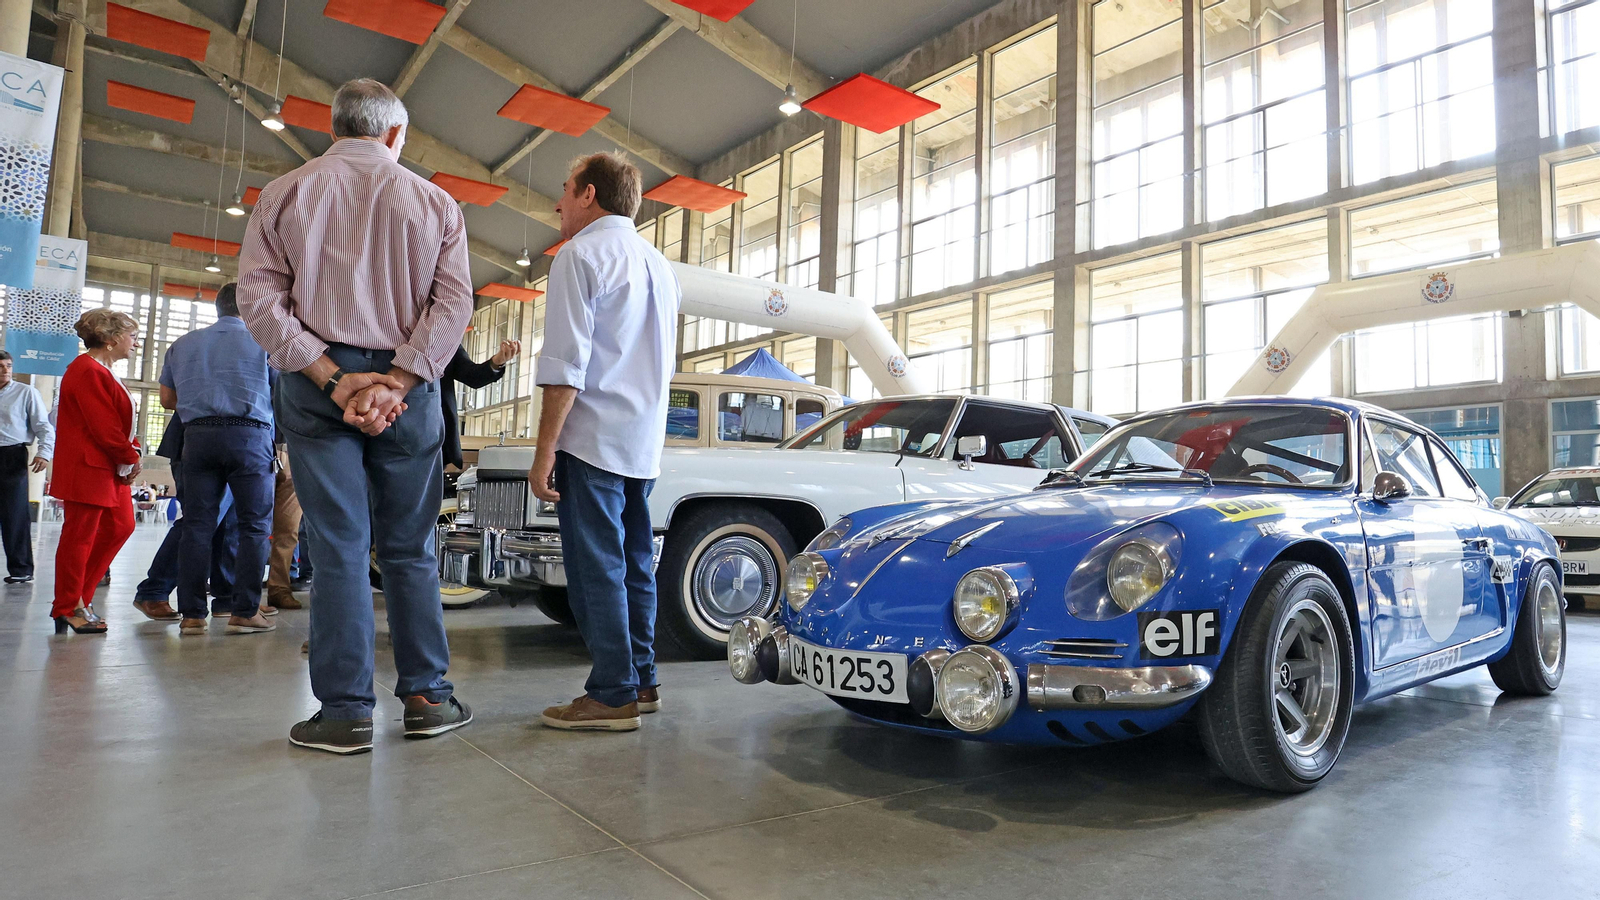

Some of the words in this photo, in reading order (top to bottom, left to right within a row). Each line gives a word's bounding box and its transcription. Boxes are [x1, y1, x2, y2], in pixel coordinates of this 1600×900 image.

[1562, 562, 1586, 573] BRM
[1143, 612, 1215, 657] elf
[793, 643, 809, 680] CA
[812, 651, 895, 695] 61253
